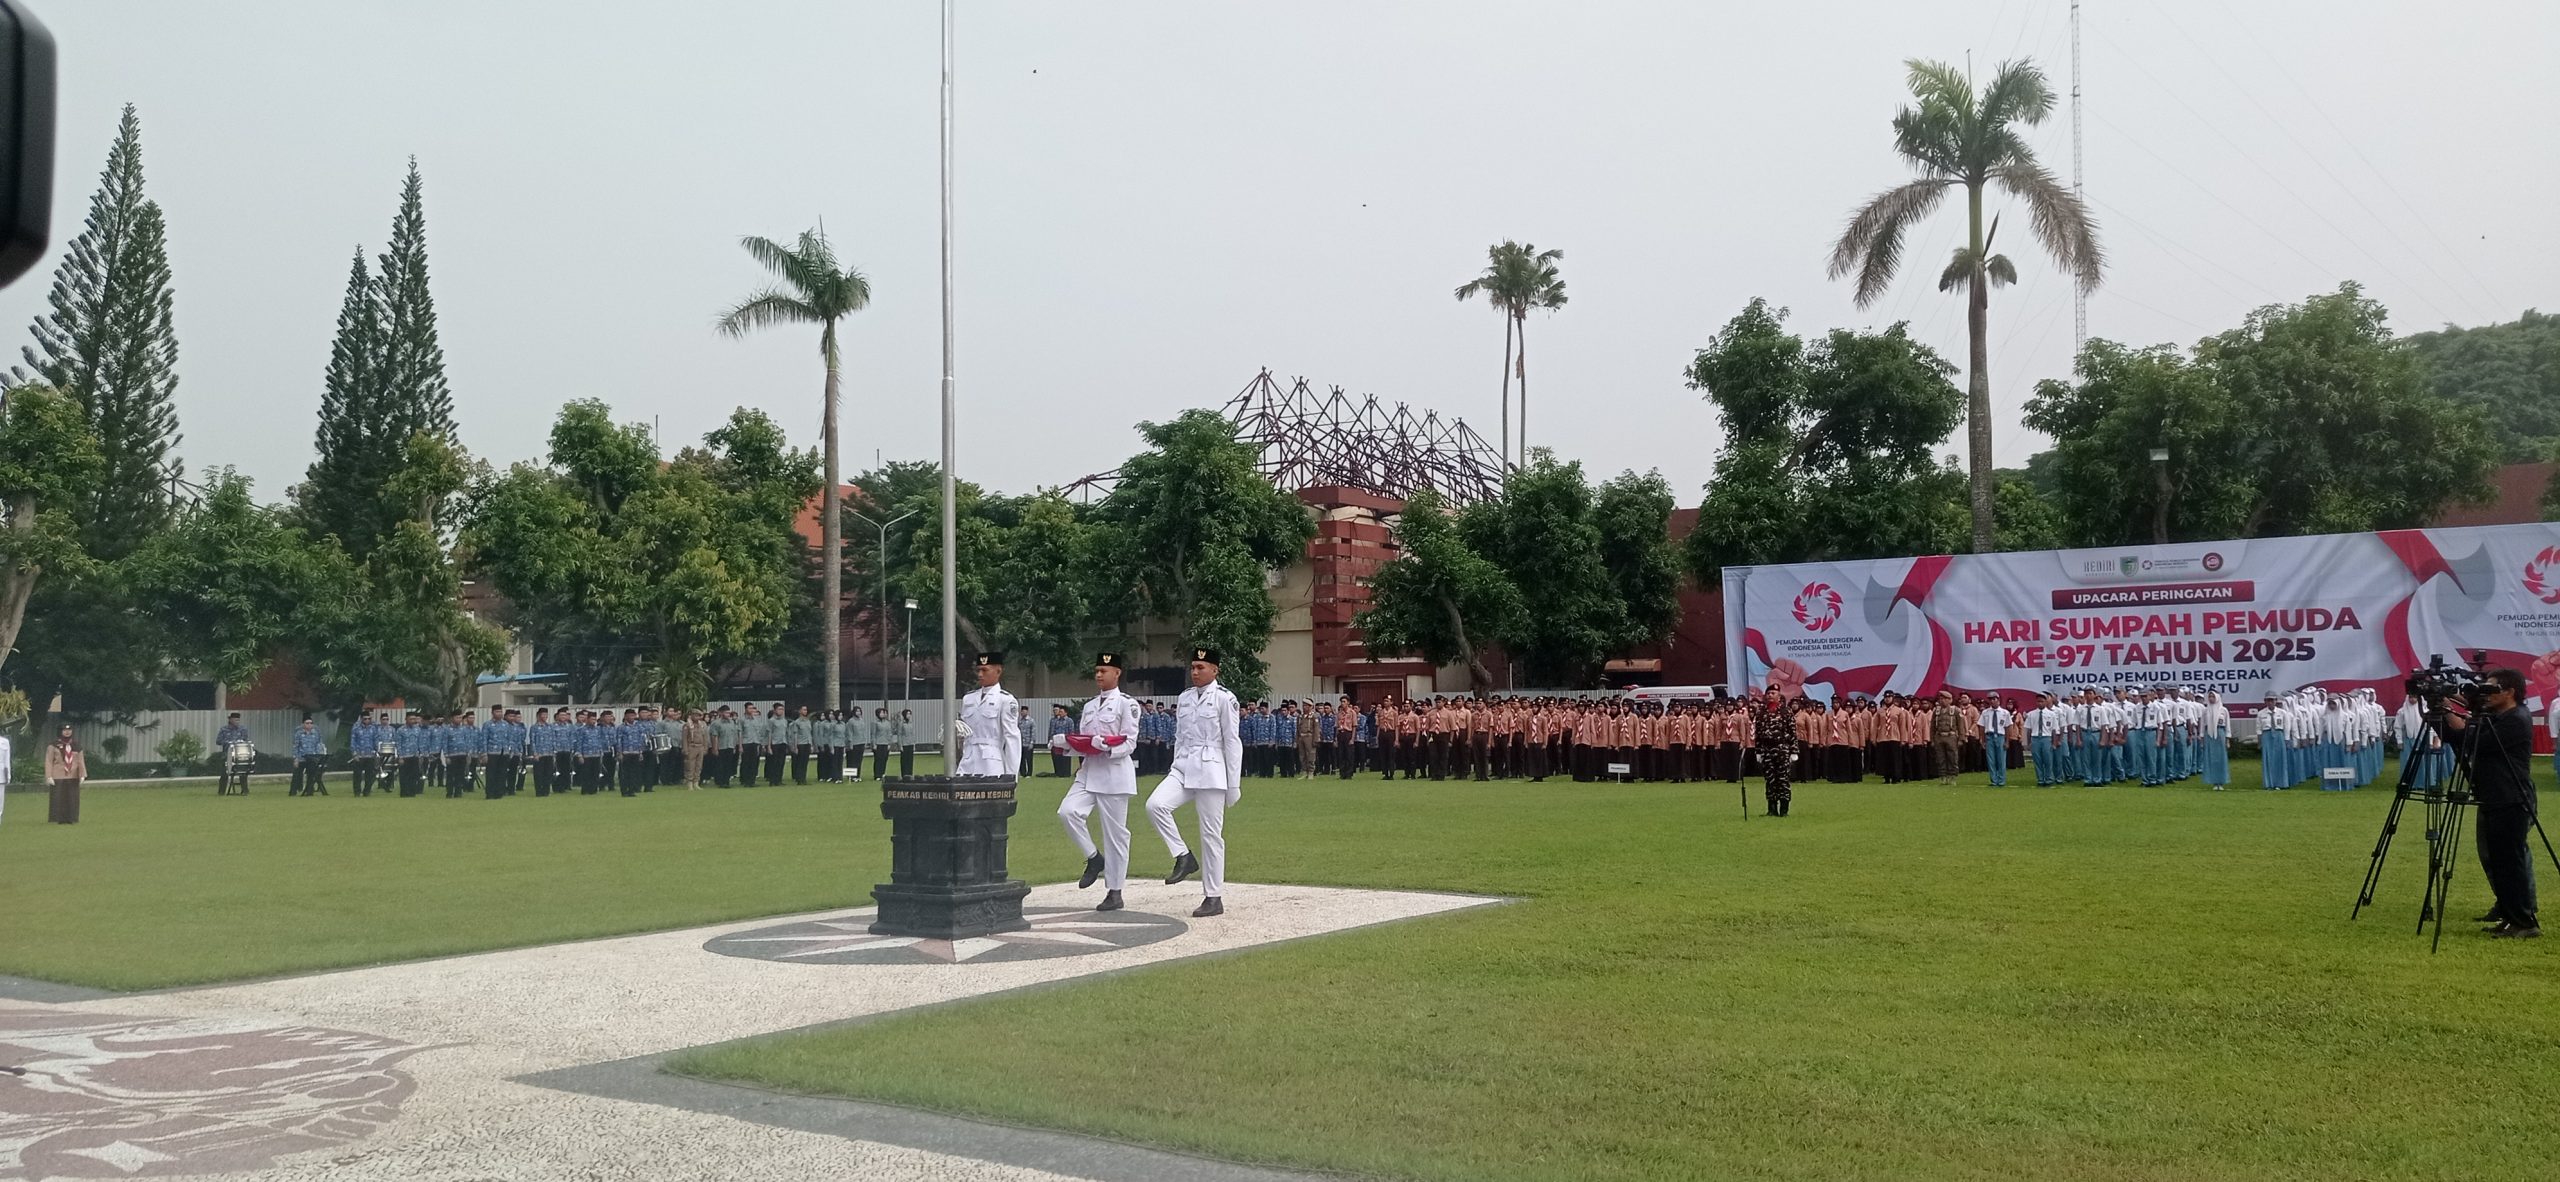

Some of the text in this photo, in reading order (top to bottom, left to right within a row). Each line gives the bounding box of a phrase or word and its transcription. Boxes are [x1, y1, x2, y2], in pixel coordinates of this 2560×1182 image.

[2072, 587, 2233, 604] UPACARA PERINGATAN
[1964, 607, 2362, 644] HARI SUMPAH PEMUDA
[2004, 637, 2316, 669] KE-97 TAHUN 2025
[2043, 668, 2272, 685] PEMUDA PEMUDI BERGERAK
[887, 790, 949, 800] PEMKAB KEDIRI
[955, 790, 1012, 800] PEMKAB KEDIRI
